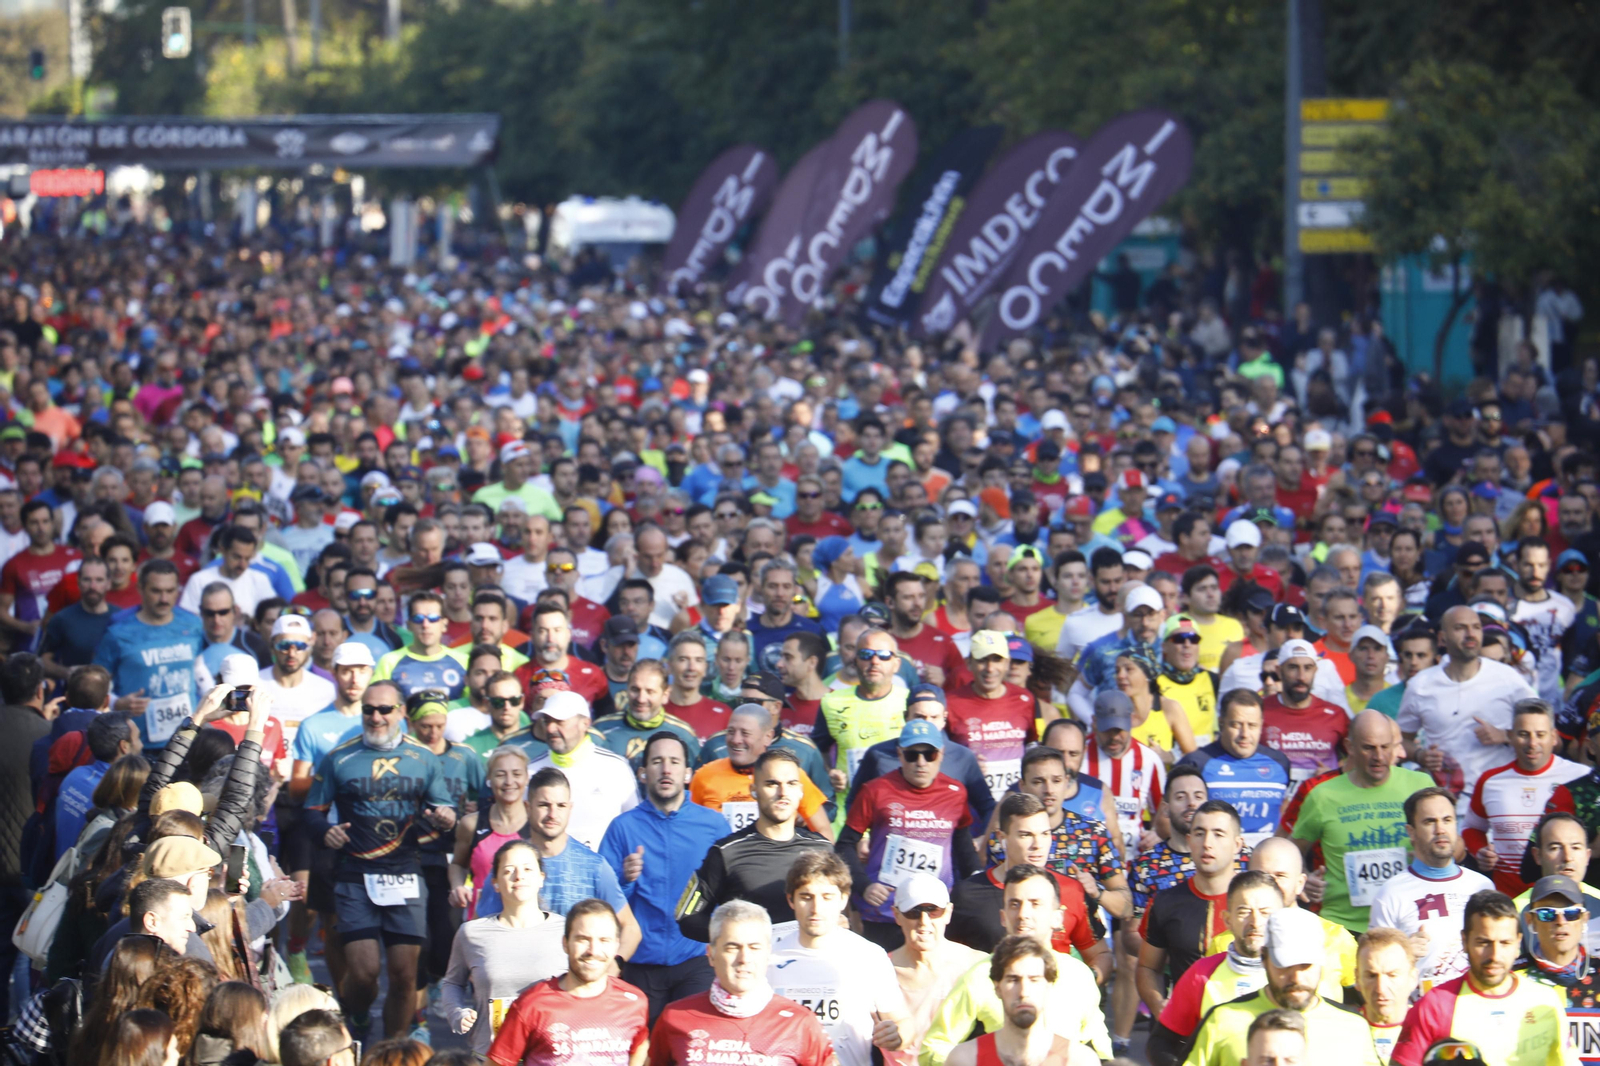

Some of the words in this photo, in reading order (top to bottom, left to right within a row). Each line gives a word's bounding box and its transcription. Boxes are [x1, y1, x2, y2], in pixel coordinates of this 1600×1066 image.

[999, 118, 1178, 332] IMDECO
[156, 703, 190, 723] 3846
[982, 720, 1013, 732] MEDIA
[967, 731, 982, 742] 36
[1281, 732, 1314, 741] MEDIA
[1282, 739, 1332, 750] MARATÓN
[904, 809, 937, 820] MEDIA
[1337, 803, 1371, 815] CARRERA
[888, 817, 904, 828] 36
[904, 817, 953, 829] MARATÓN
[1492, 821, 1538, 835] ESP
[896, 847, 938, 872] 3124
[1358, 860, 1404, 881] 4088
[793, 999, 840, 1021] 546
[570, 1027, 613, 1042] MEDIA
[551, 1042, 571, 1056] 36
[572, 1037, 632, 1054] MARATÓN
[707, 1039, 753, 1053] MEDIA
[685, 1049, 704, 1062] 36
